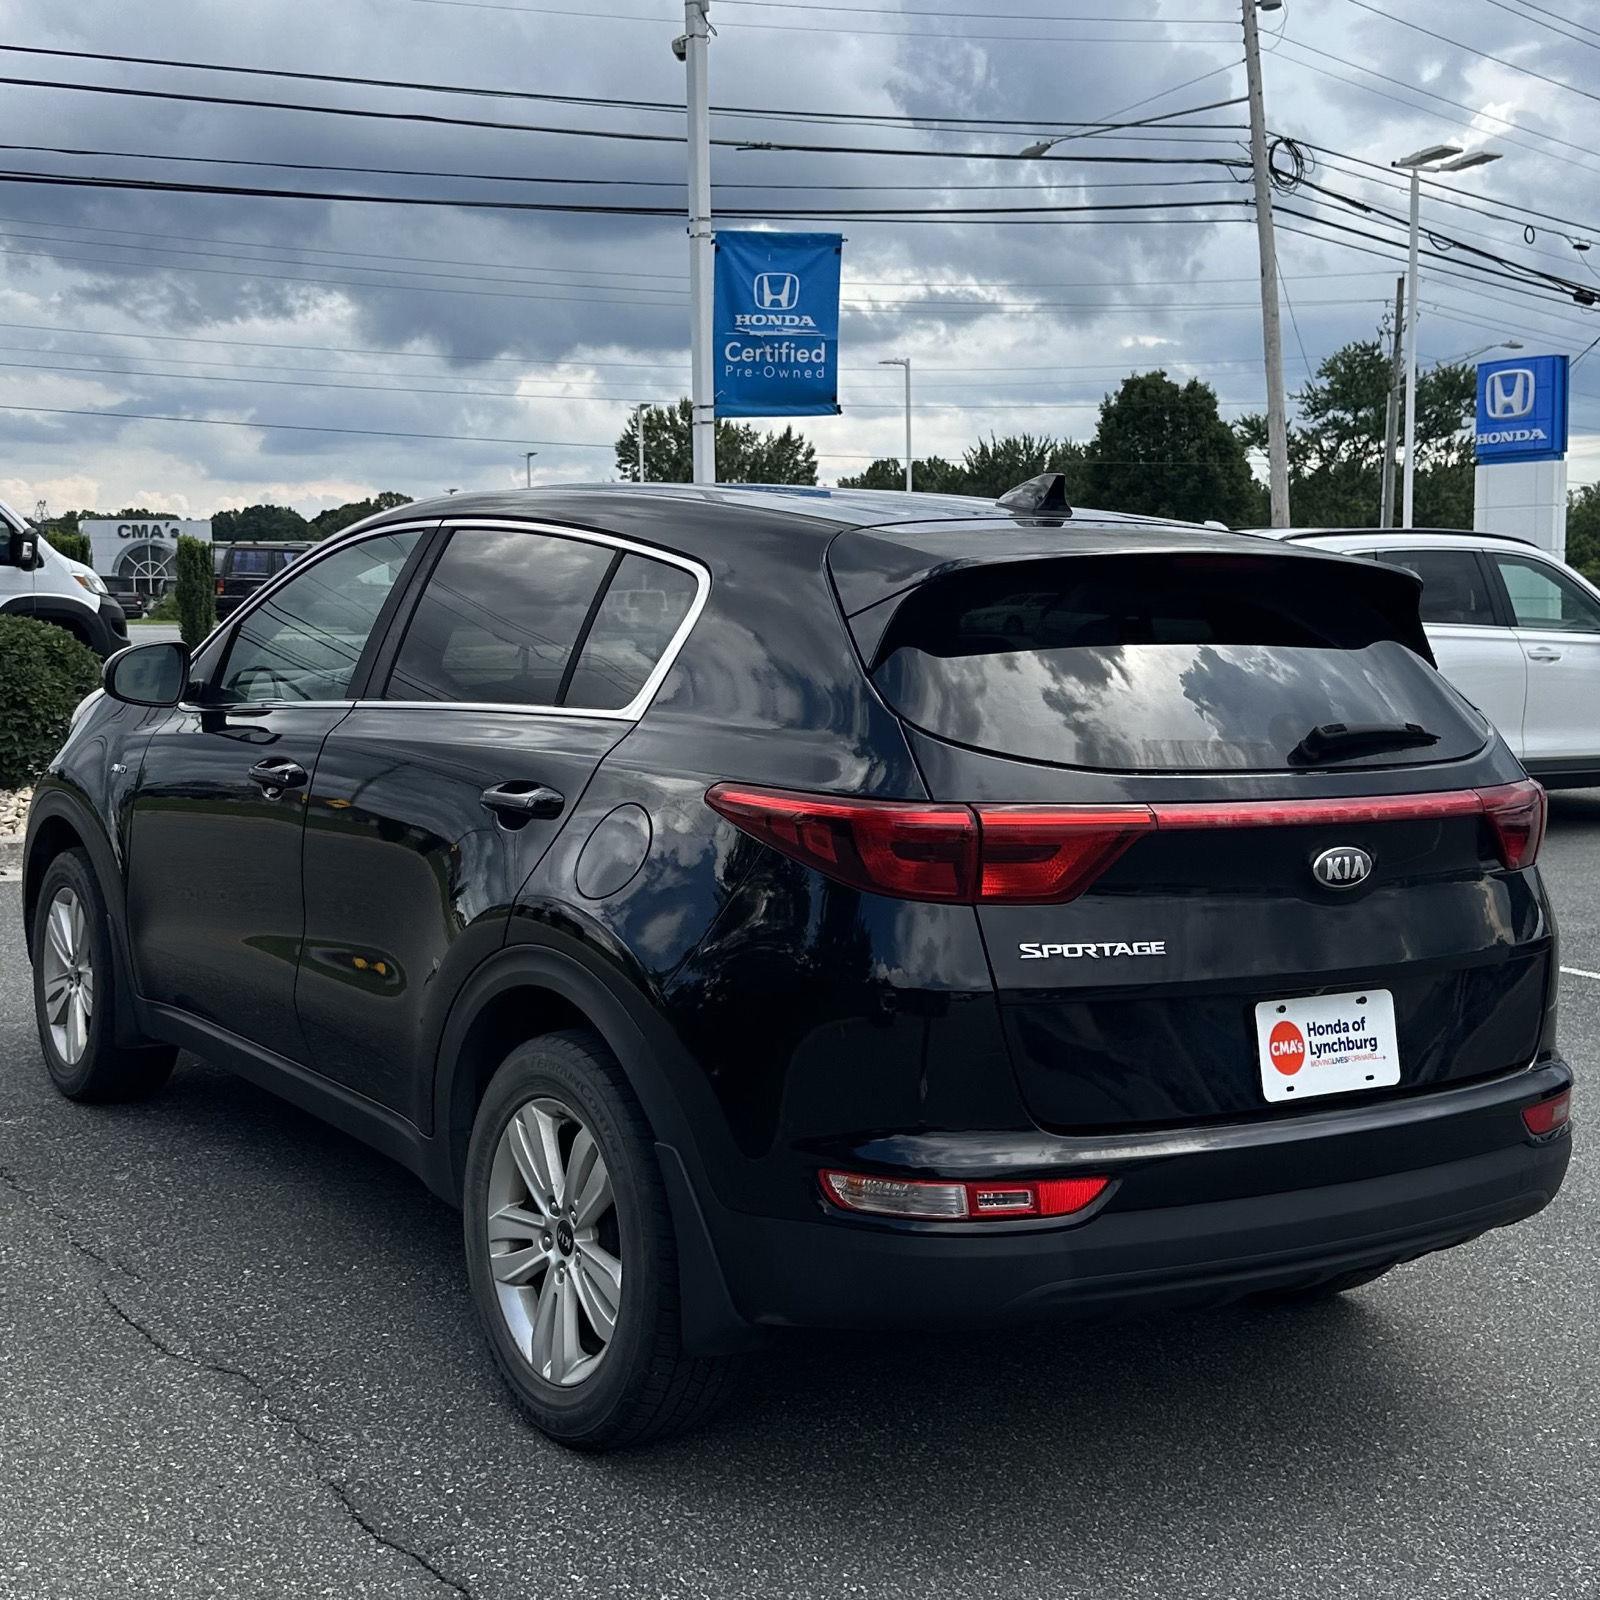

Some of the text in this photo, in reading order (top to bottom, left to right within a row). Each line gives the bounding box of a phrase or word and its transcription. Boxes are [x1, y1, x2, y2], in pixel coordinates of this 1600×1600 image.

[735, 313, 817, 327] HONDA
[724, 341, 826, 363] Certified
[725, 364, 825, 379] Pre-Owned
[1475, 428, 1548, 446] HONDA
[117, 522, 180, 539] CMA's
[1326, 855, 1365, 880] KIA
[1019, 941, 1167, 959] SPORTAGE
[1306, 1016, 1366, 1038] Honda of
[1308, 1036, 1378, 1059] Lynchburg
